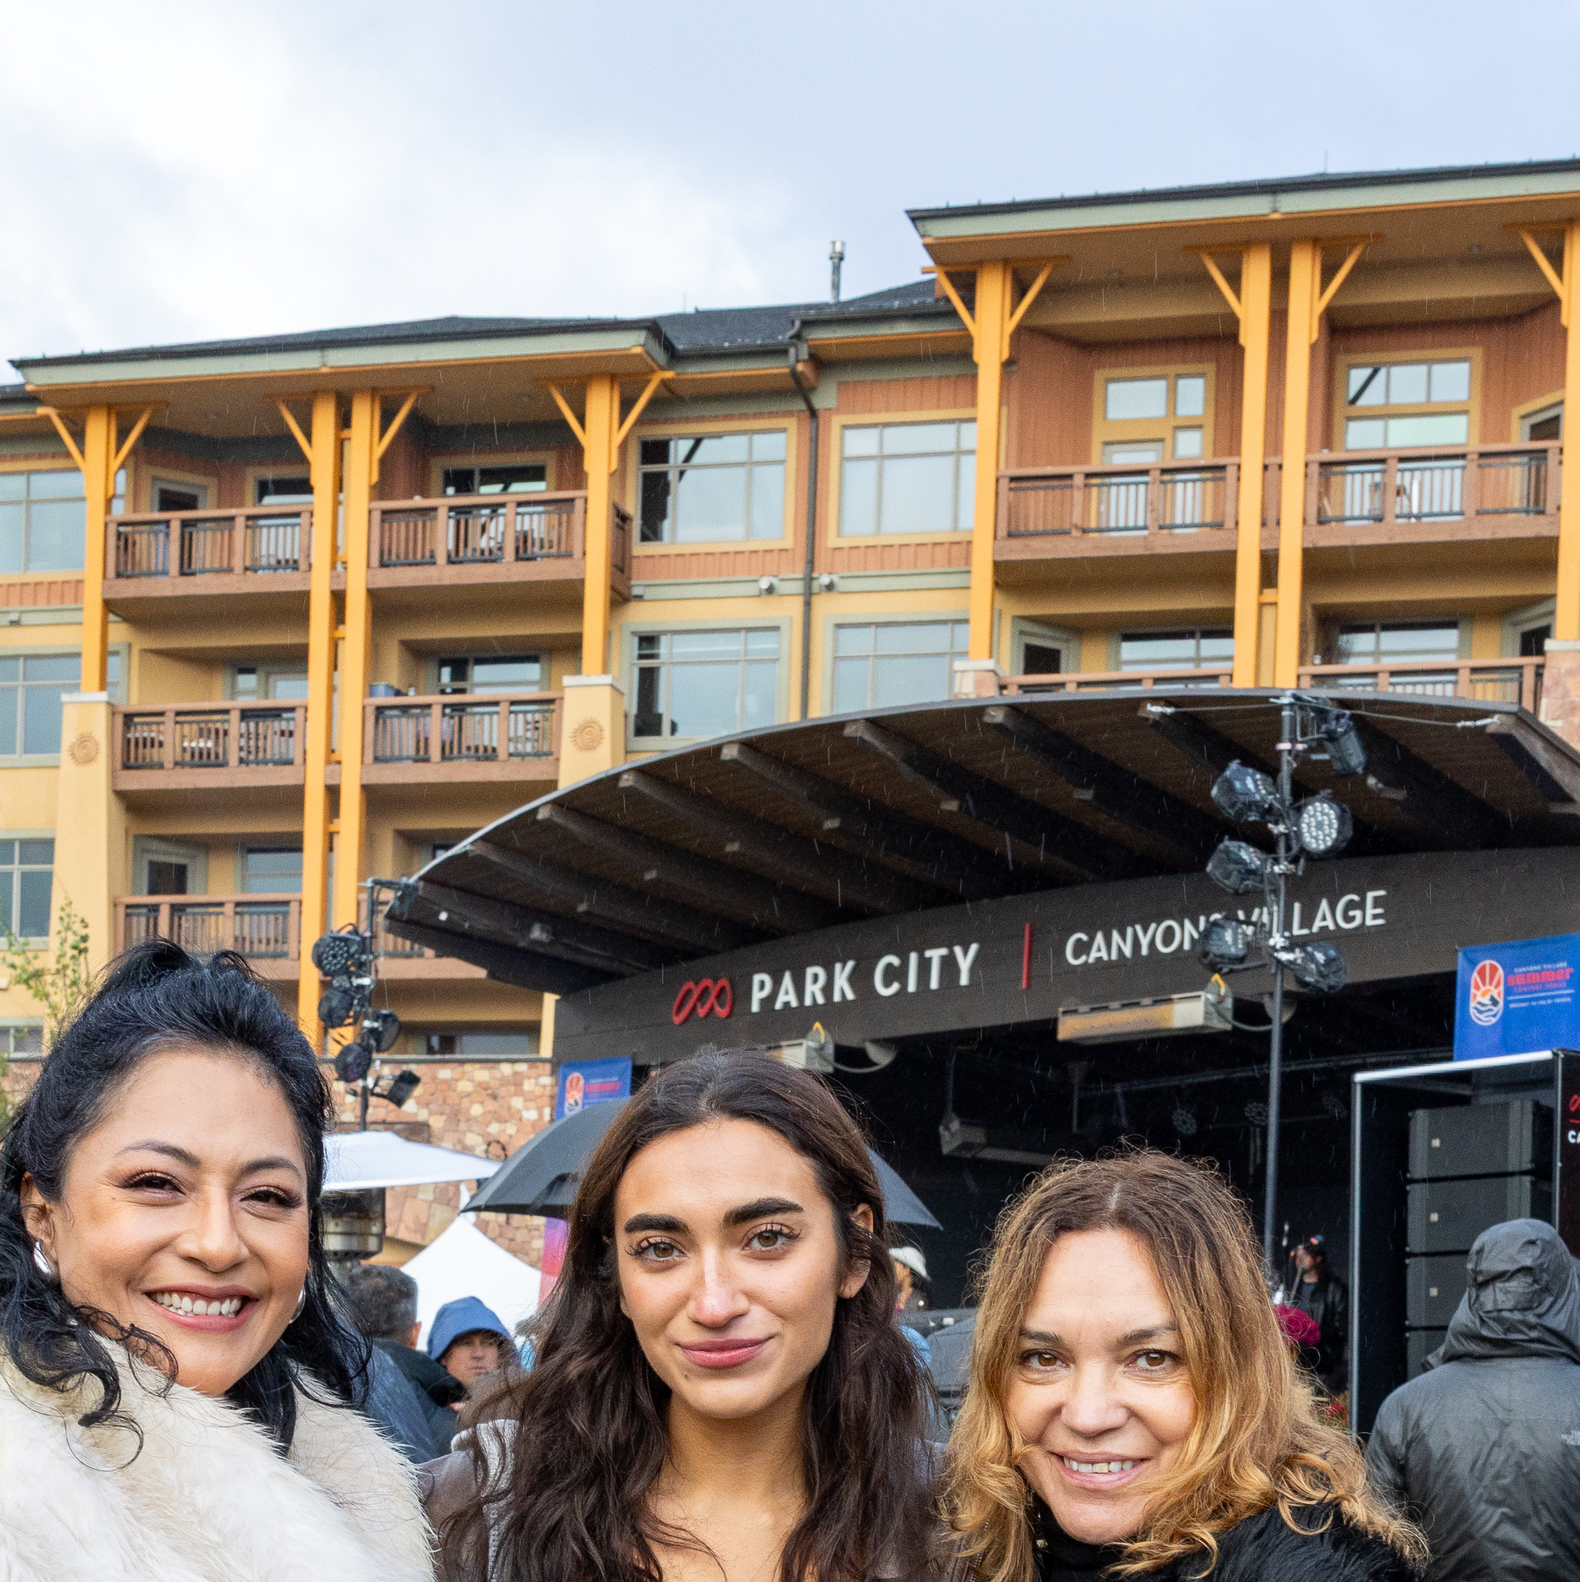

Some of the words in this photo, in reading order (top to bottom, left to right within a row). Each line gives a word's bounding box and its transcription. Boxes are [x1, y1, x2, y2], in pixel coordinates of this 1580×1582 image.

[1065, 913, 1225, 965] CANYON
[751, 960, 856, 1013] PARK
[873, 943, 980, 997] CITY
[1507, 967, 1574, 987] summer
